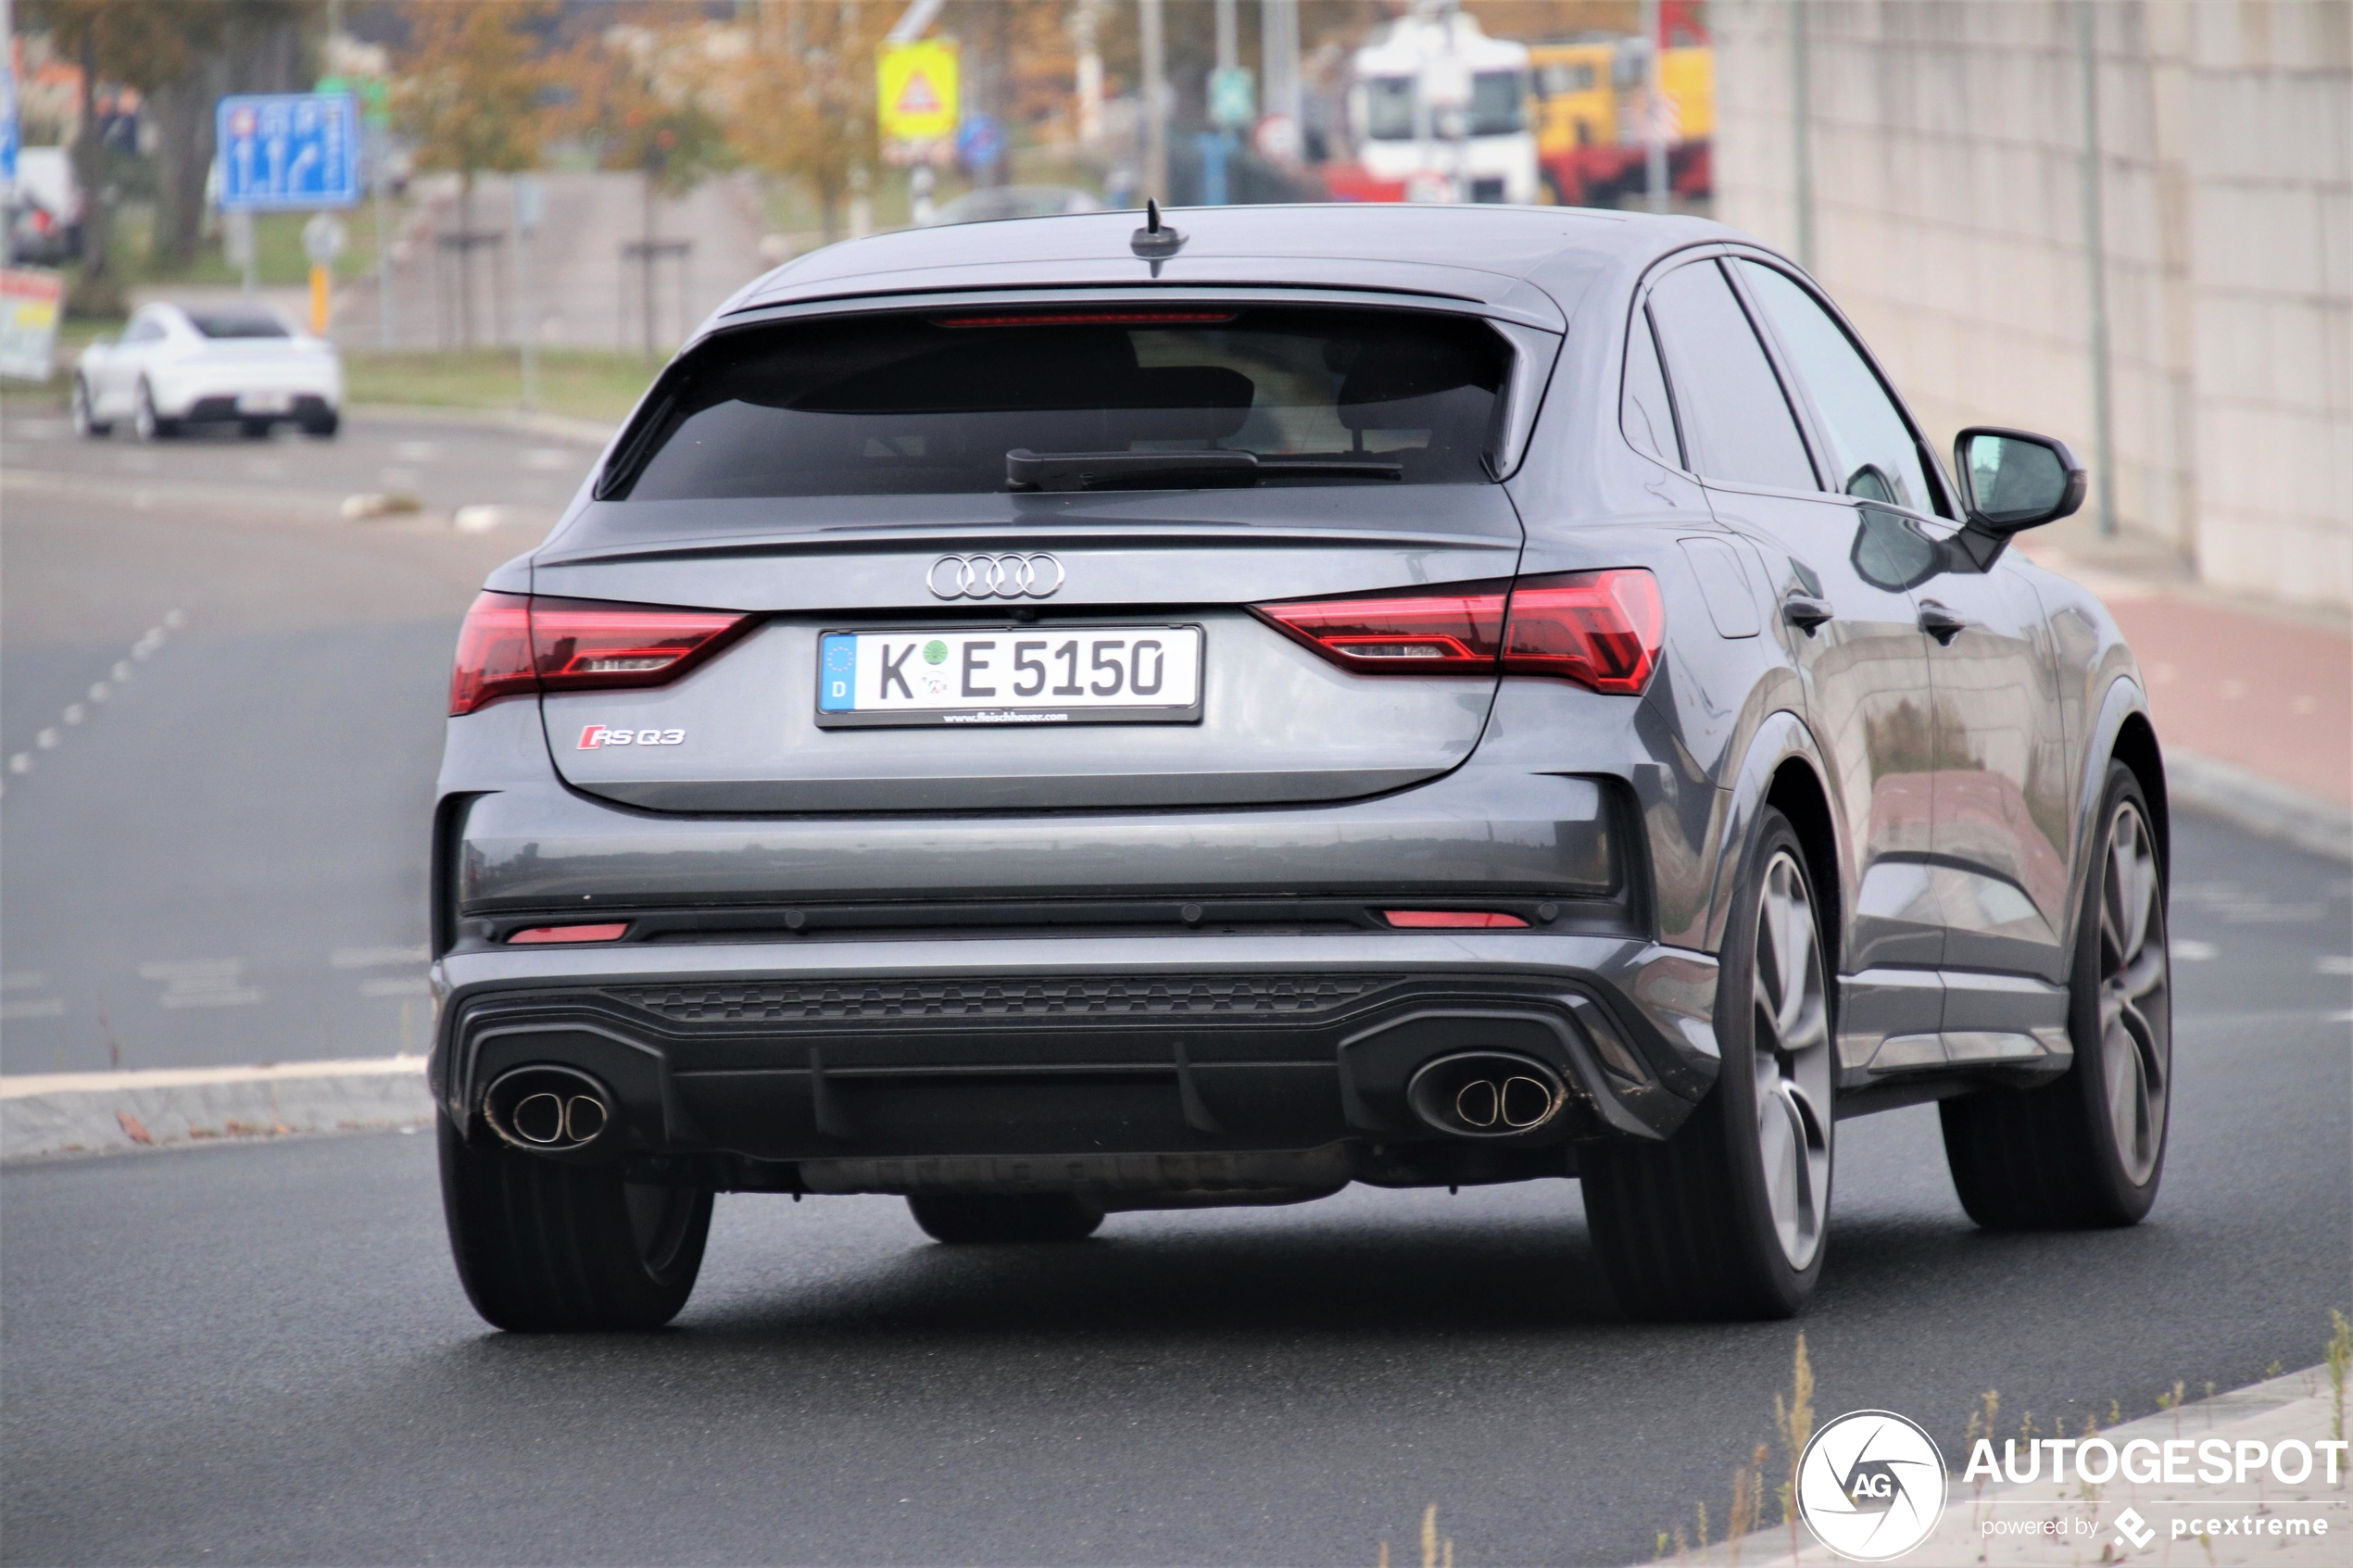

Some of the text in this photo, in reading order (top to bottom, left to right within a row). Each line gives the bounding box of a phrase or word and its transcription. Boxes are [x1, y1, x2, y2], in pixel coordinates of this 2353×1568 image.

[880, 639, 1164, 699] K E 5150
[832, 681, 847, 697] D
[943, 711, 1068, 722] www.fleischhauer.com
[584, 727, 686, 746] RS Q3
